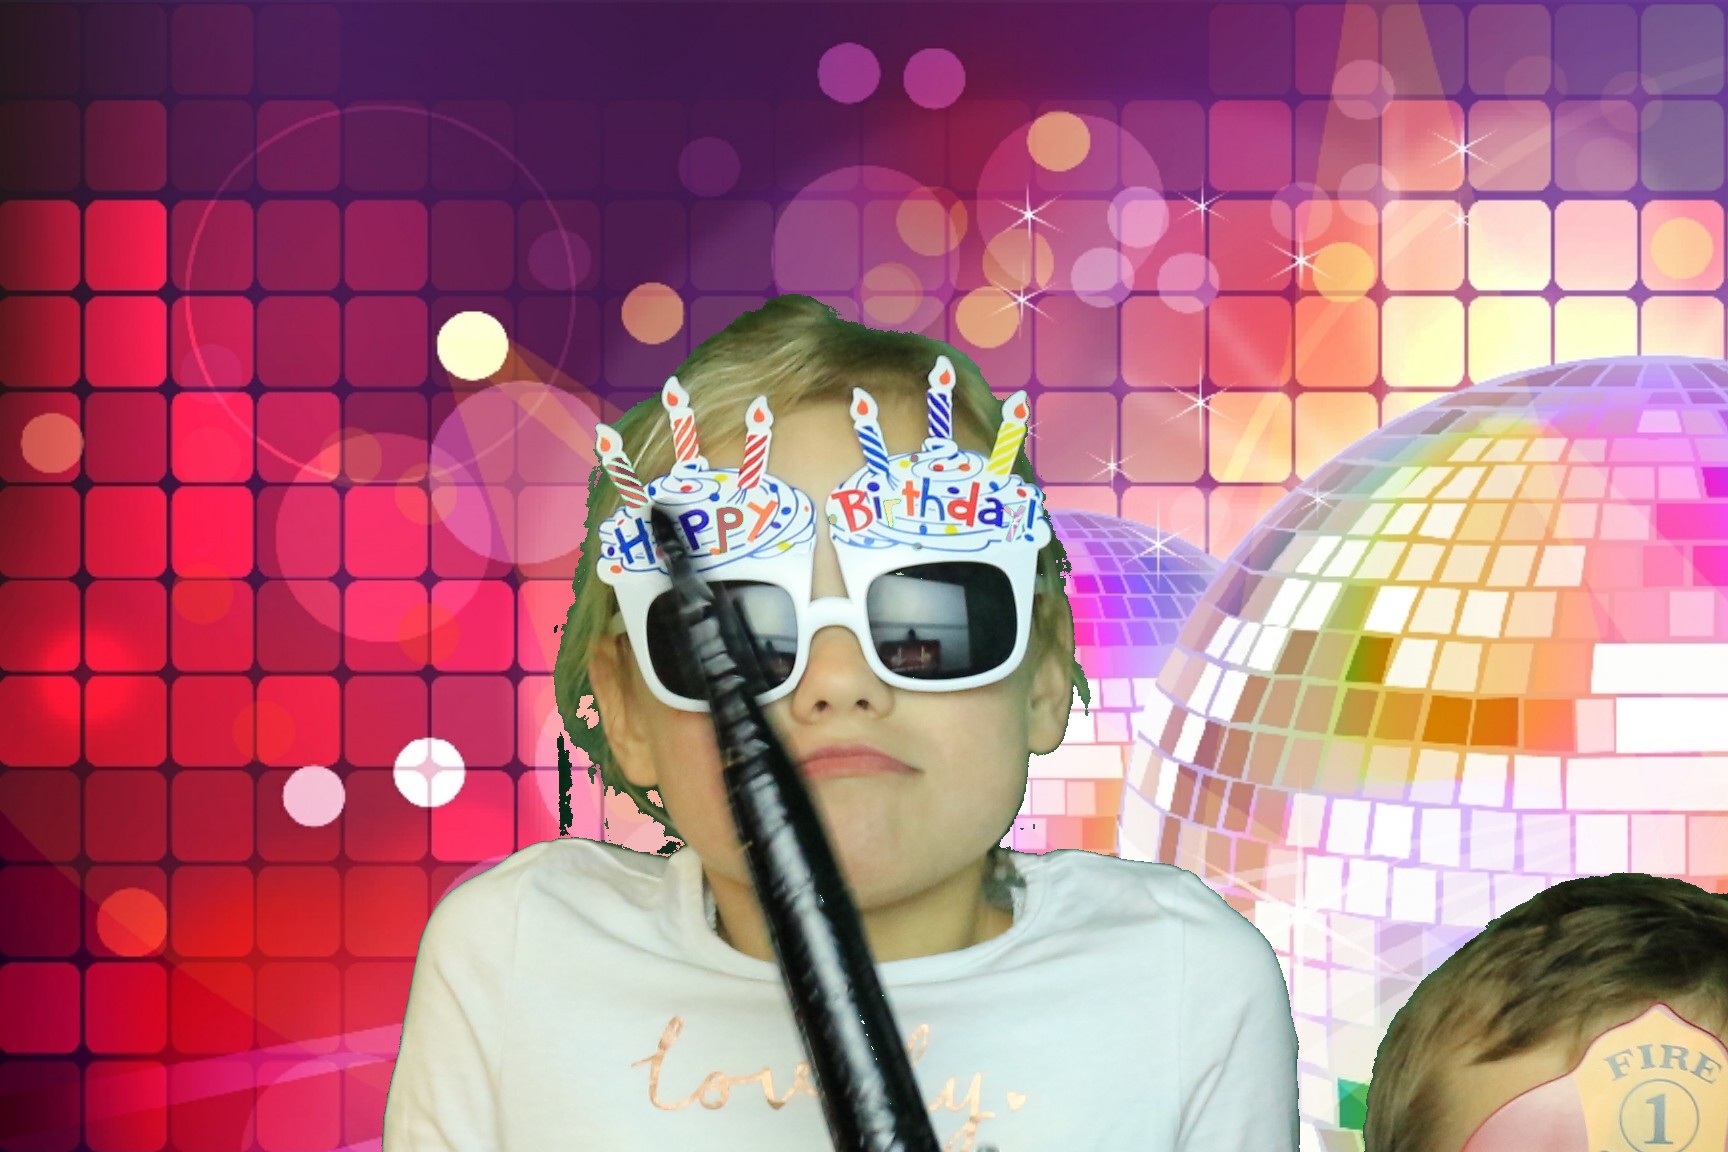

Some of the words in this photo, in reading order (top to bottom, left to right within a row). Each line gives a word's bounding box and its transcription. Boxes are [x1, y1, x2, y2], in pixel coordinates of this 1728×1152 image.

[614, 499, 778, 566] HPPY
[1604, 1043, 1724, 1084] FIRE
[1642, 1092, 1674, 1145] 1
